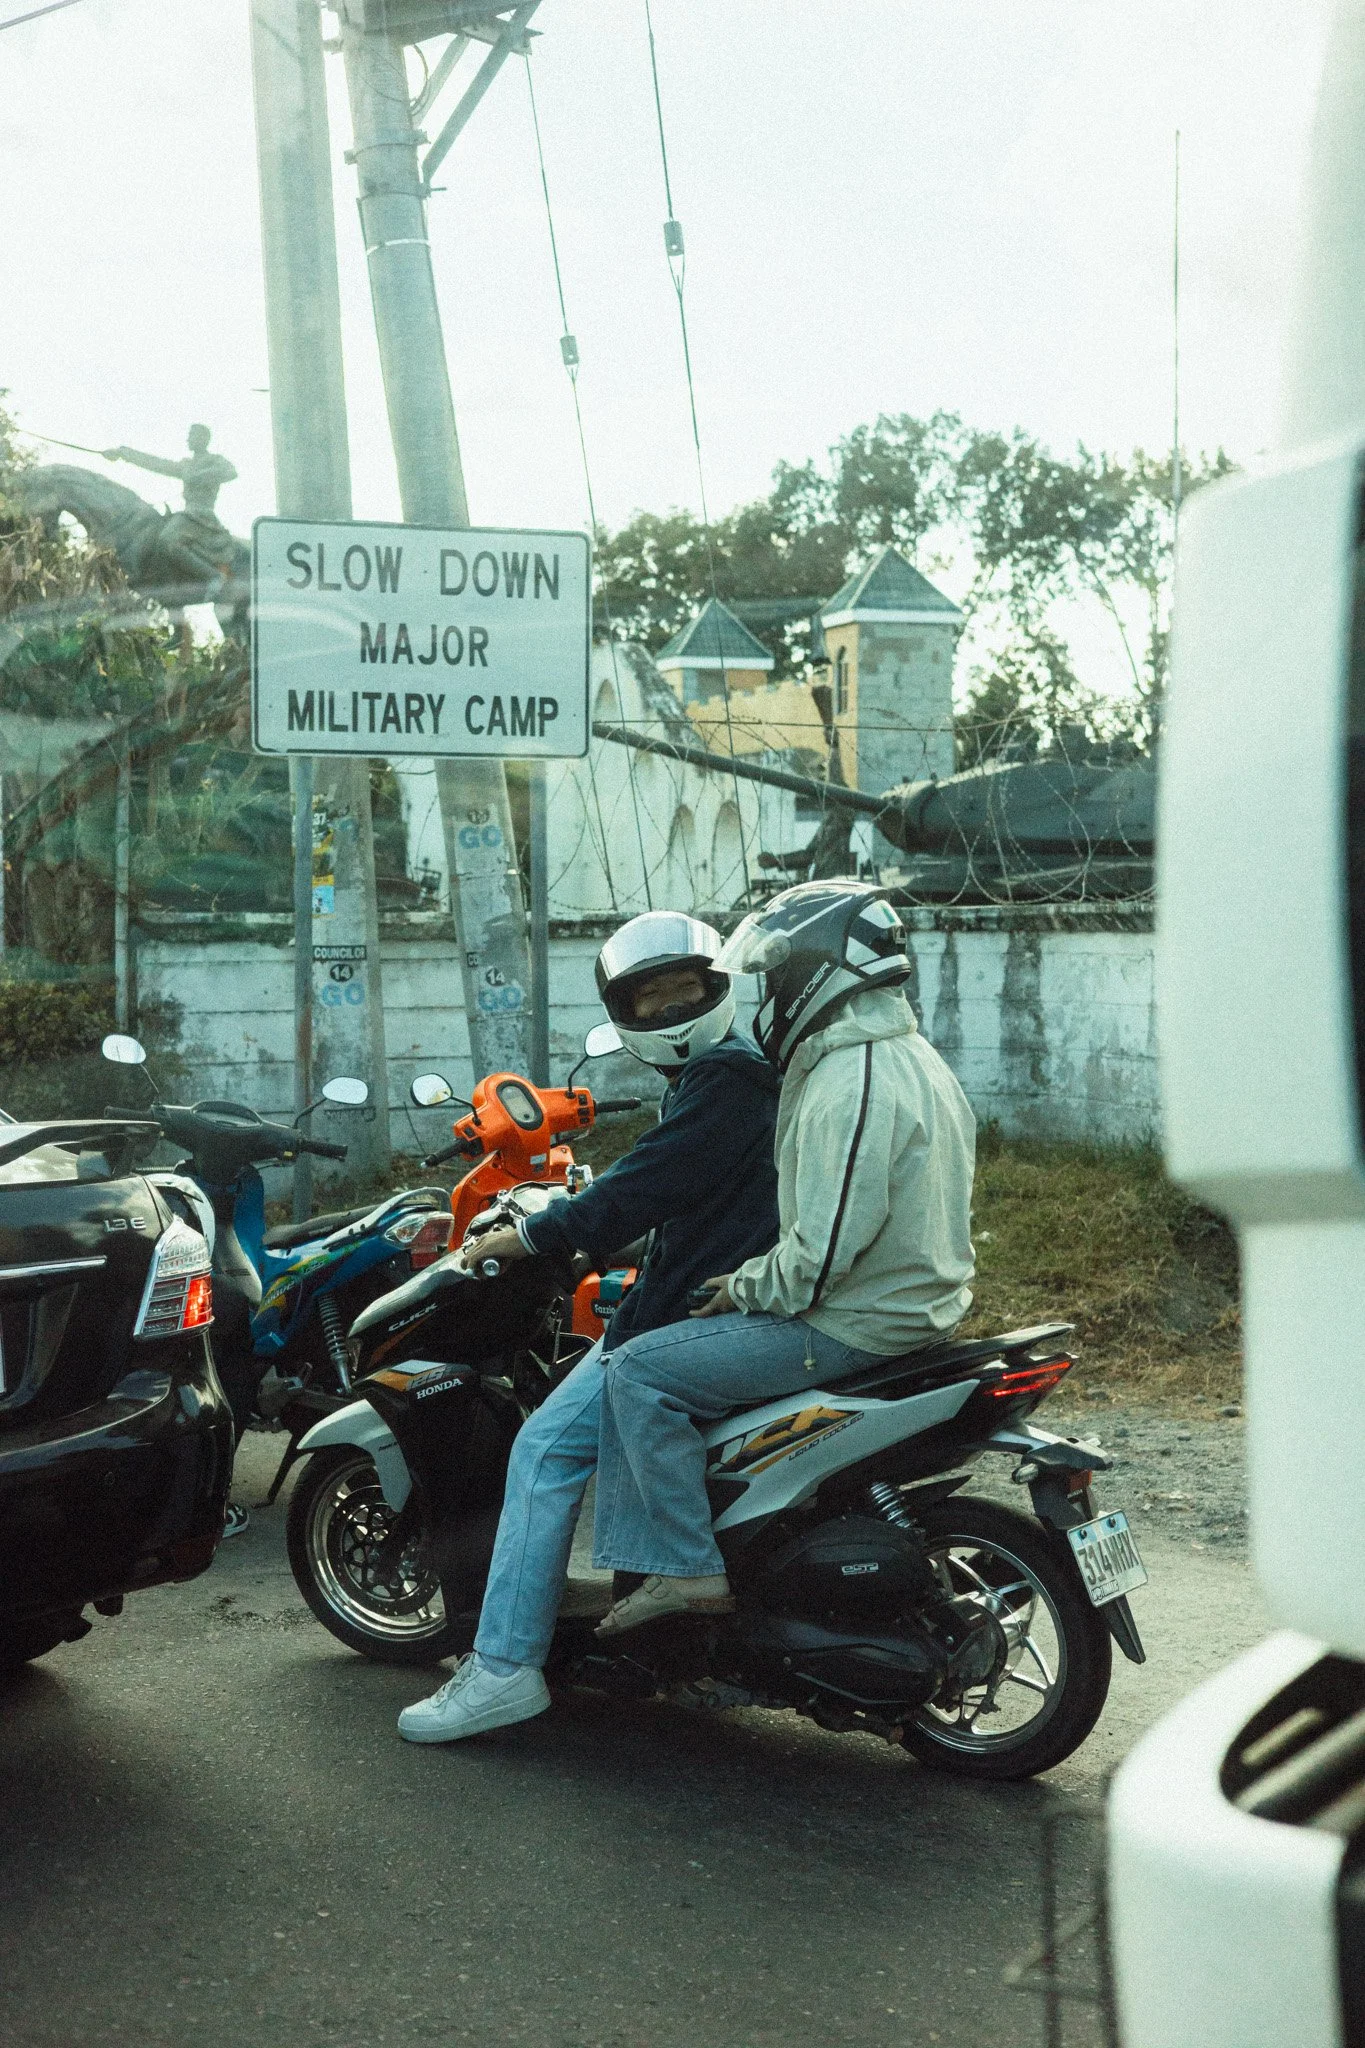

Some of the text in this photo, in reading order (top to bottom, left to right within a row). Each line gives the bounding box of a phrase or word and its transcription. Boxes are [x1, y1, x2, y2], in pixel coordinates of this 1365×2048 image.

[286, 542, 560, 600] SLOW DOWN
[360, 621, 489, 667] MAJOR
[287, 689, 559, 738] MILITARY CAMP
[458, 824, 503, 850] GO
[331, 965, 352, 981] 14
[487, 969, 506, 985] 14
[321, 983, 366, 1007] GO
[478, 987, 522, 1011] GO
[784, 961, 831, 1020] SPYDER
[387, 1302, 439, 1332] CLICK
[415, 1377, 464, 1400] HONDA
[788, 1412, 865, 1462] LIQUID COOLED
